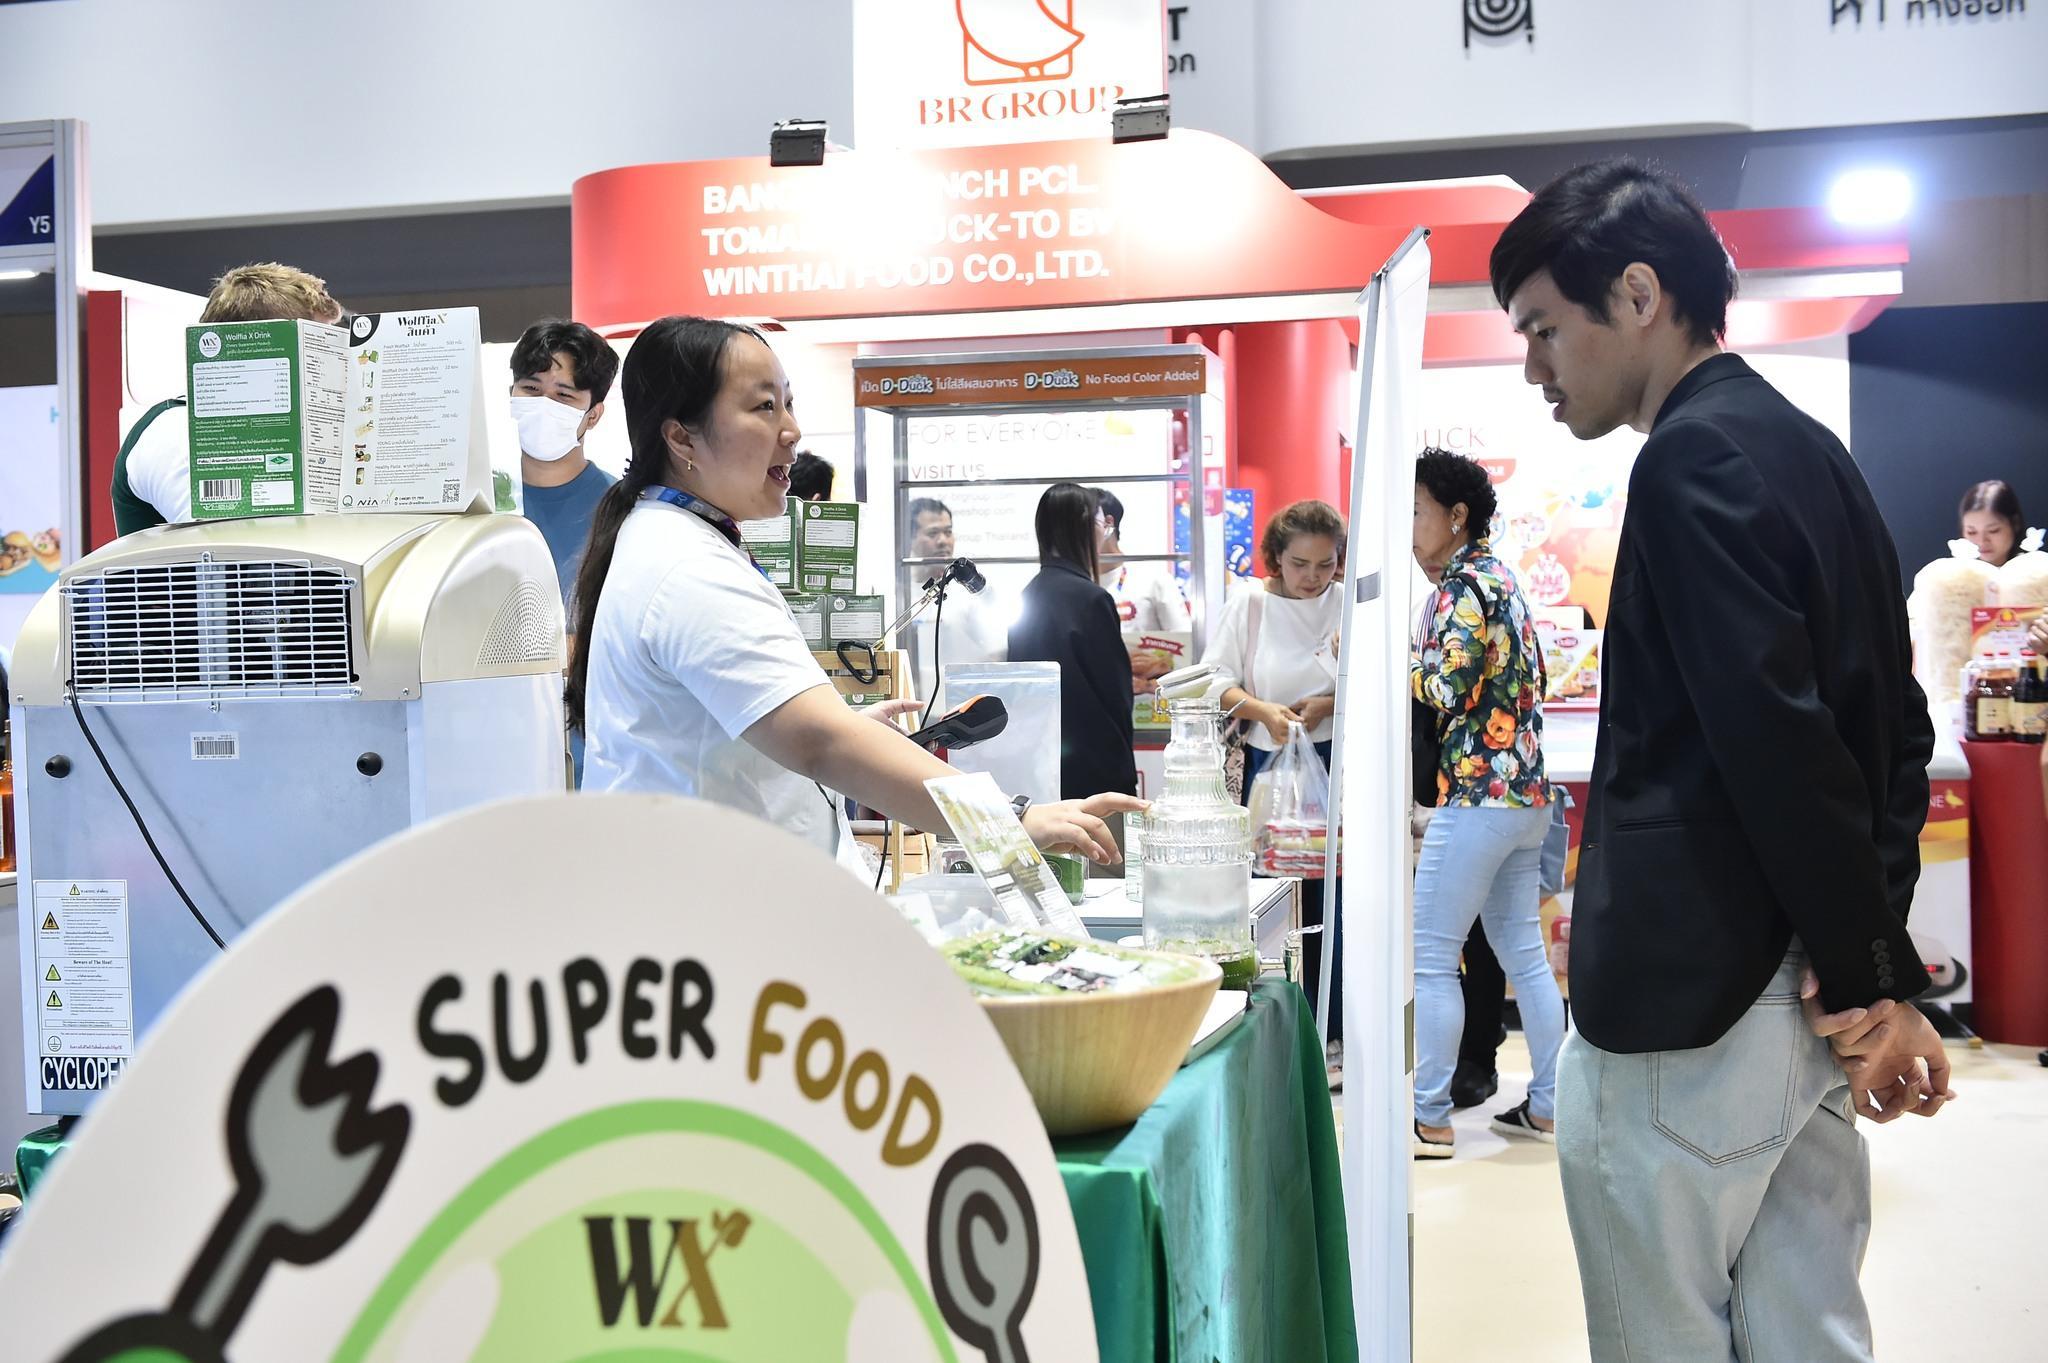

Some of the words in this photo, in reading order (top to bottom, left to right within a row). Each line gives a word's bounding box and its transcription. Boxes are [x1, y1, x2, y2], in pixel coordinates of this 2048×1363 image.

[919, 97, 973, 125] BR
[982, 85, 1124, 121] GROUP
[28, 215, 51, 234] Y5
[930, 209, 1061, 245] UCK-TO
[962, 249, 1111, 285] CO.,LTD.
[225, 333, 248, 341] Wolffia
[407, 325, 436, 337] สินค้า
[880, 374, 934, 395] D-Duck
[1024, 368, 1080, 390] D-Duck
[1086, 374, 1101, 385] No
[1103, 373, 1131, 384] Food
[1132, 372, 1162, 383] Color
[1164, 370, 1200, 381] Added
[908, 423, 957, 445] FOR
[966, 418, 1096, 443] EVERYONE
[1416, 426, 1486, 449] UCK
[911, 465, 956, 479] VISIT
[961, 463, 985, 478] US
[416, 955, 716, 1108] SUPER
[745, 978, 942, 1168] FOOD
[583, 1209, 740, 1331] WX
